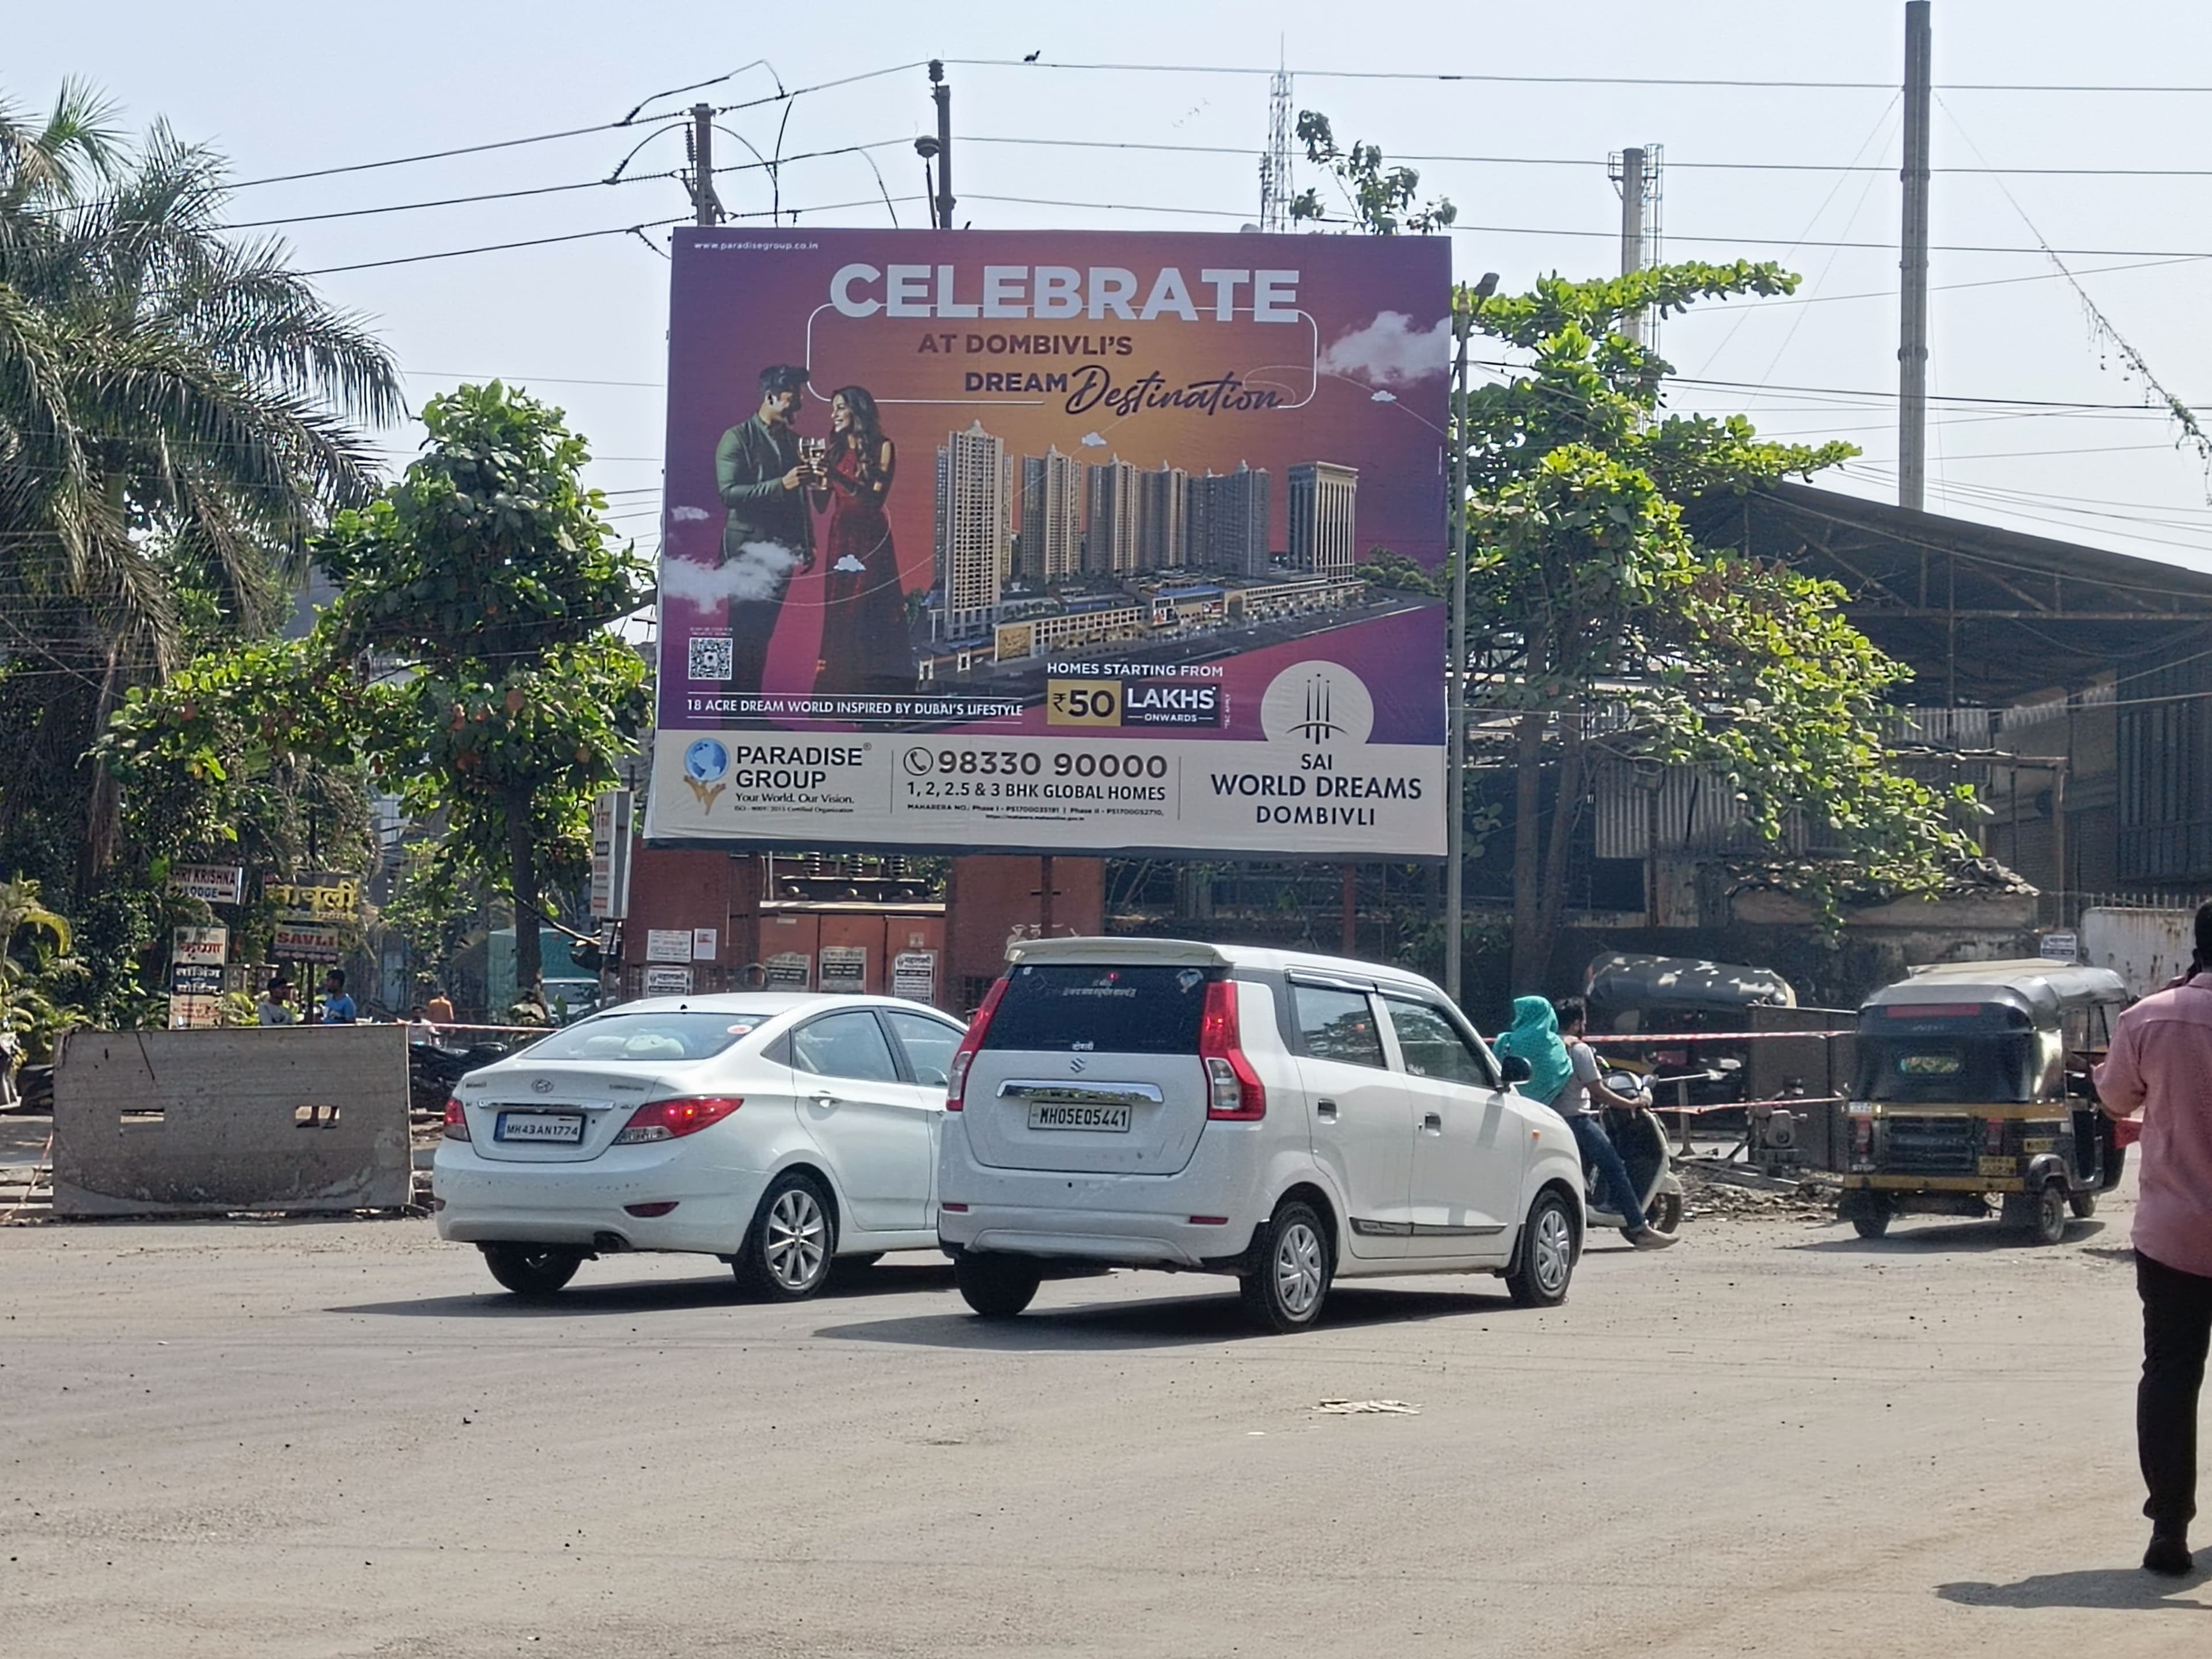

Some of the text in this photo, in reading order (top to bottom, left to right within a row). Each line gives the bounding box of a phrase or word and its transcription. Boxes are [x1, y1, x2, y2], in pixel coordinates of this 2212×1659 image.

[694, 242, 819, 251] www.paradisegroup.co.in
[830, 263, 1300, 323] CELEBRATE
[918, 334, 1133, 356] AT DOMBIVLI'S
[965, 365, 1284, 416] DREAM Destination
[1047, 662, 1224, 677] HOMES STARTING FROM
[687, 699, 1023, 716] 18 ACRE DREAM WORLD INSPIRED BY DUBAI'S LIFESTYLE
[1144, 713, 1198, 722] ONWARDS
[737, 746, 862, 766] PARADISE
[938, 751, 1168, 778] 98330 90000
[1301, 753, 1333, 771] SAI
[736, 770, 827, 789] GROUP
[1211, 774, 1422, 800] WORLD DREAMS
[736, 793, 855, 804] Your World. Our Vision.
[907, 781, 1166, 801] 1, 2, 2.5 & 3 BHK GLOBAL HOMES
[1256, 805, 1375, 826] DOMBIVLI
[193, 869, 236, 886] KRISHNA
[277, 931, 335, 947] SAVLI
[1039, 1107, 1127, 1127] MH05EQ5441
[506, 1126, 578, 1136] MH43AN1774
